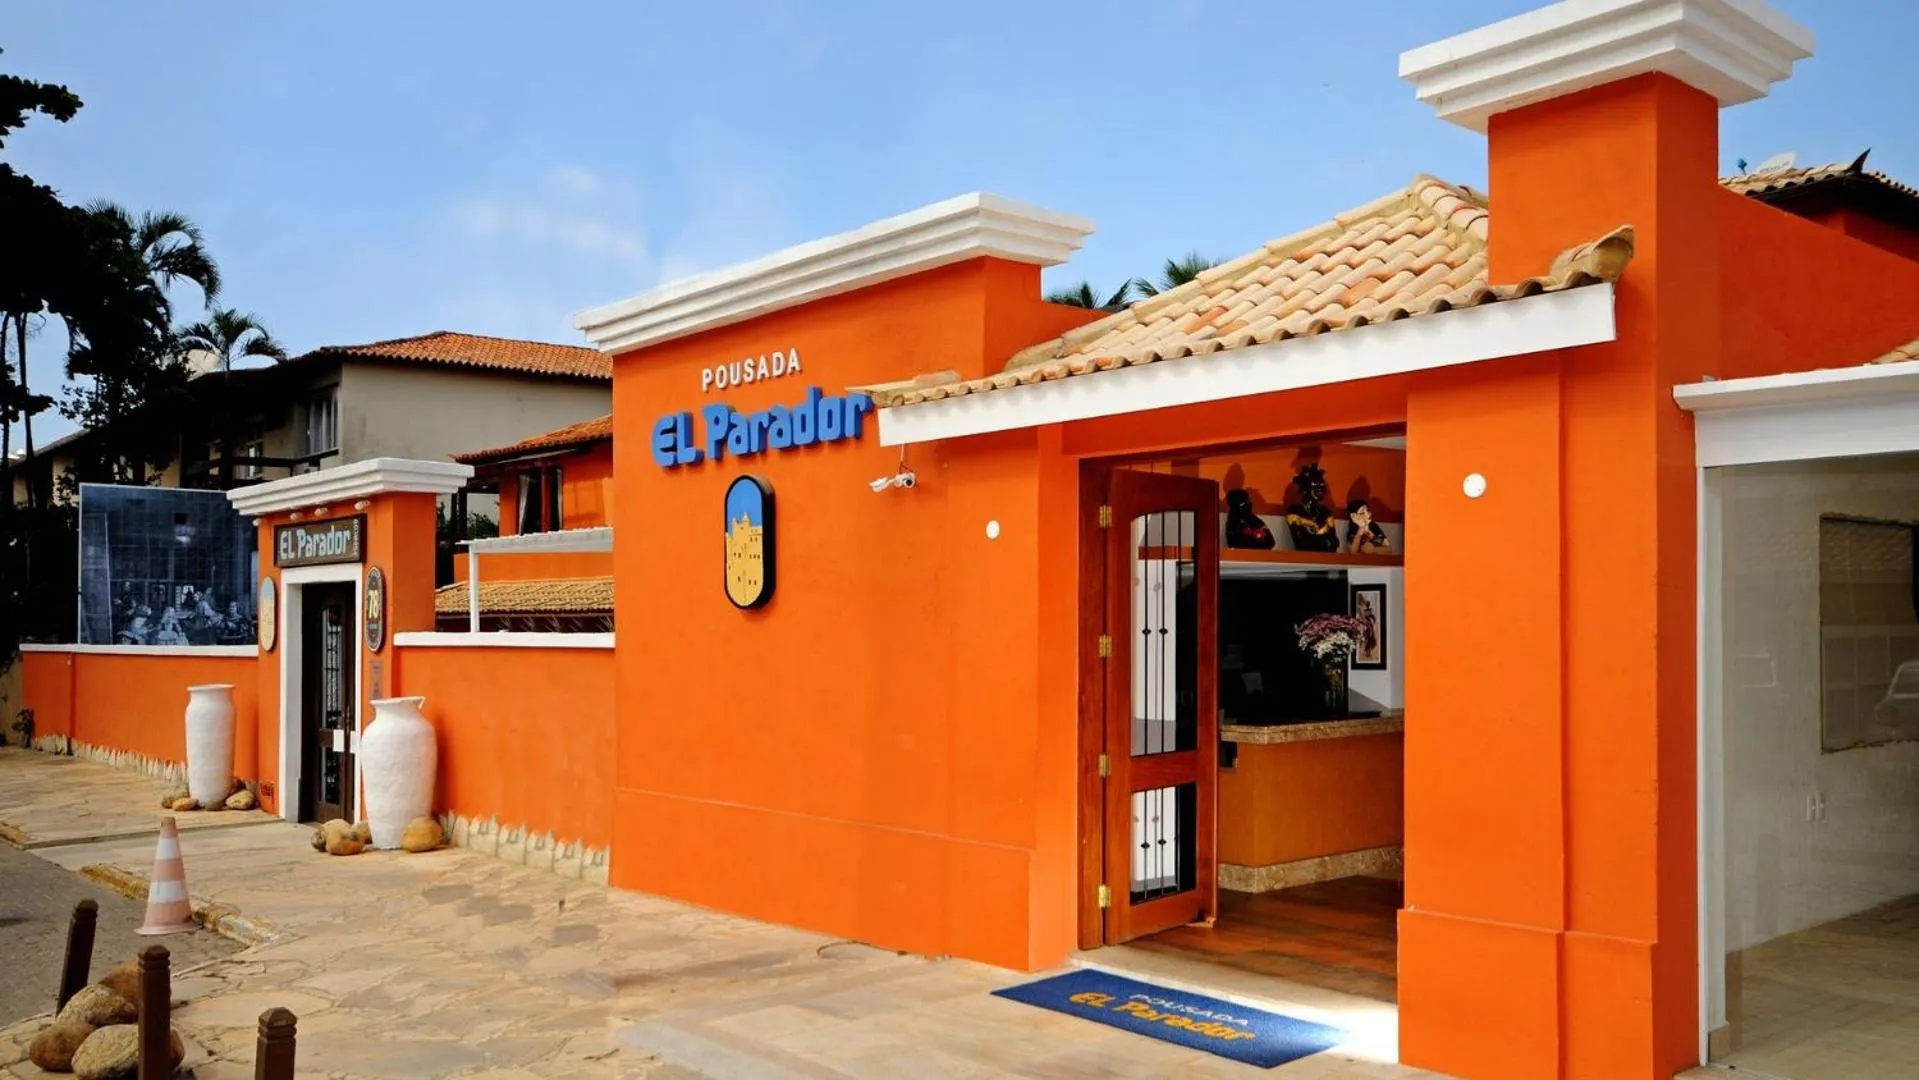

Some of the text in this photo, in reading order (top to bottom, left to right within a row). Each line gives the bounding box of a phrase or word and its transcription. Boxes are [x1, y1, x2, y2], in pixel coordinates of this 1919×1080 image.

[702, 347, 801, 391] POUSADA
[652, 386, 872, 467] EL Parador
[280, 525, 351, 560] EL Parador
[368, 589, 379, 619] 78
[1112, 1001, 1256, 1040] Parador
[1130, 993, 1249, 1026] POUSADA
